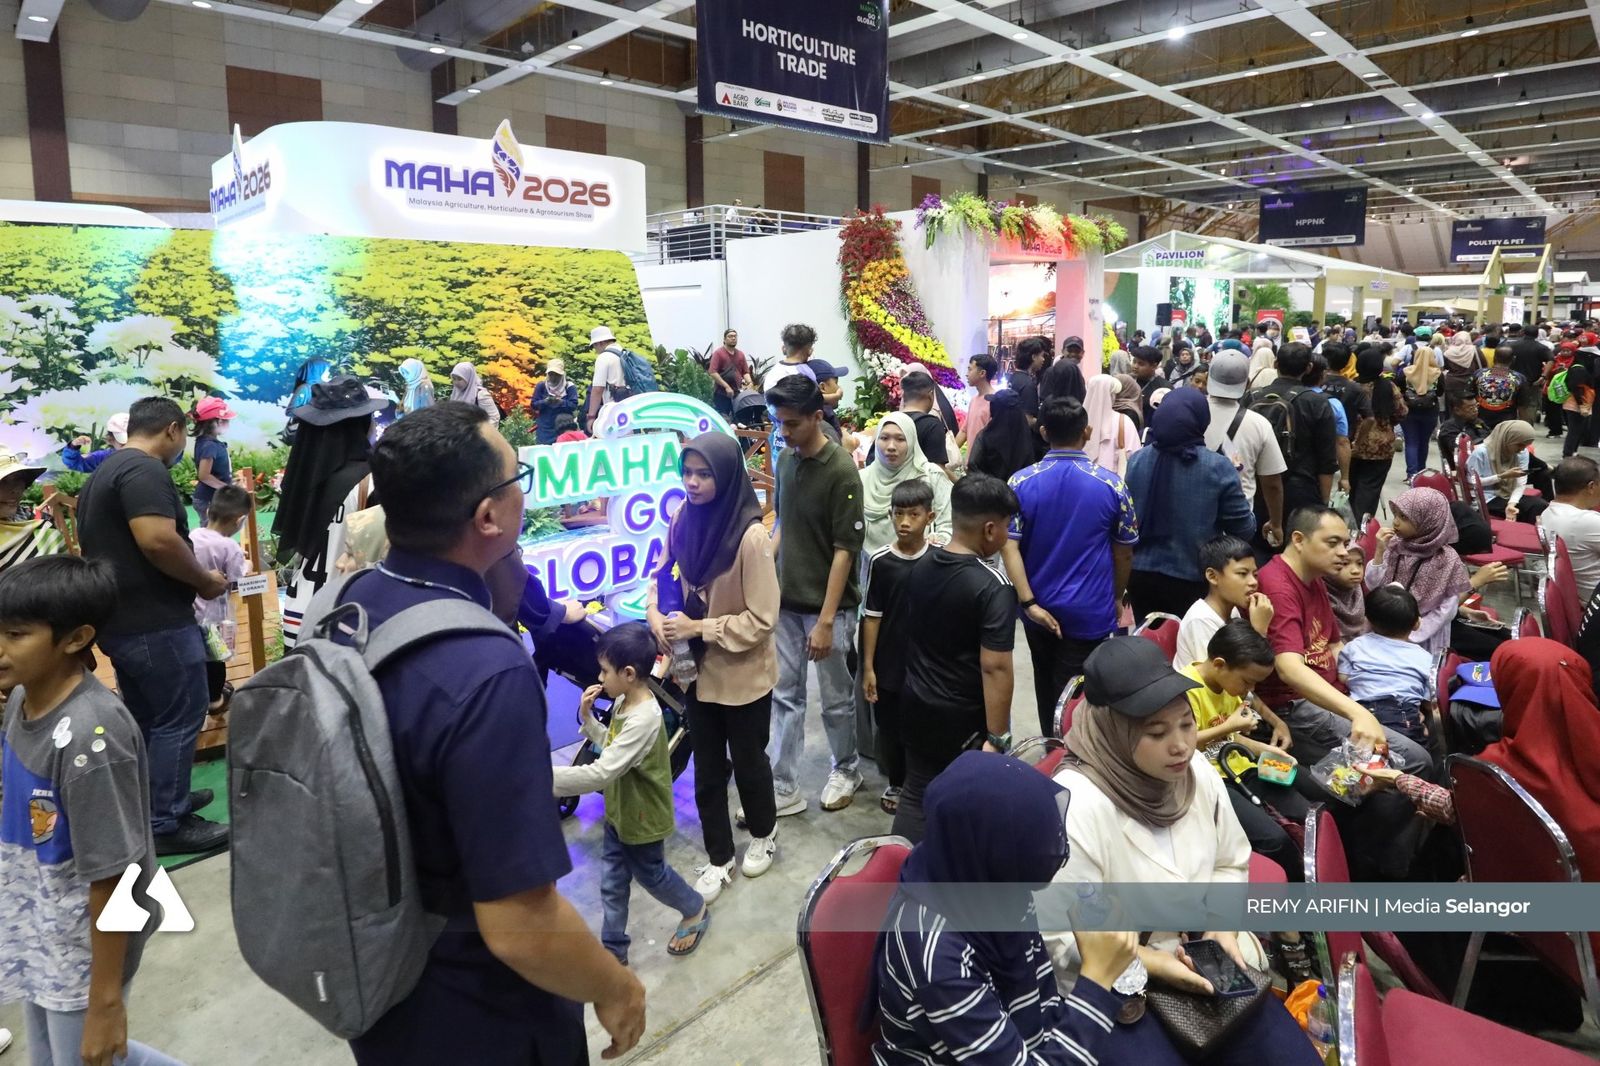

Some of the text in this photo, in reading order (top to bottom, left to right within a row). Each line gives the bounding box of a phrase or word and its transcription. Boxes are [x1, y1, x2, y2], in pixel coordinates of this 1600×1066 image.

[742, 18, 857, 66] HORTICULTURE
[777, 52, 827, 80] TRADE
[210, 181, 237, 214] MAHA
[243, 158, 272, 201] 2026
[385, 159, 611, 207] MAHA 2026
[408, 197, 443, 207] Malaysia
[444, 200, 487, 211] Agriculture,
[487, 204, 529, 214] Horticulture
[536, 209, 575, 217] Agrotourism
[575, 211, 592, 219] Show
[1295, 217, 1325, 227] HPPNK
[1155, 250, 1205, 260] PAVILION
[1468, 239, 1502, 247] POULTRY
[537, 441, 683, 500] MAHA
[239, 579, 267, 587] MAKSIMUM
